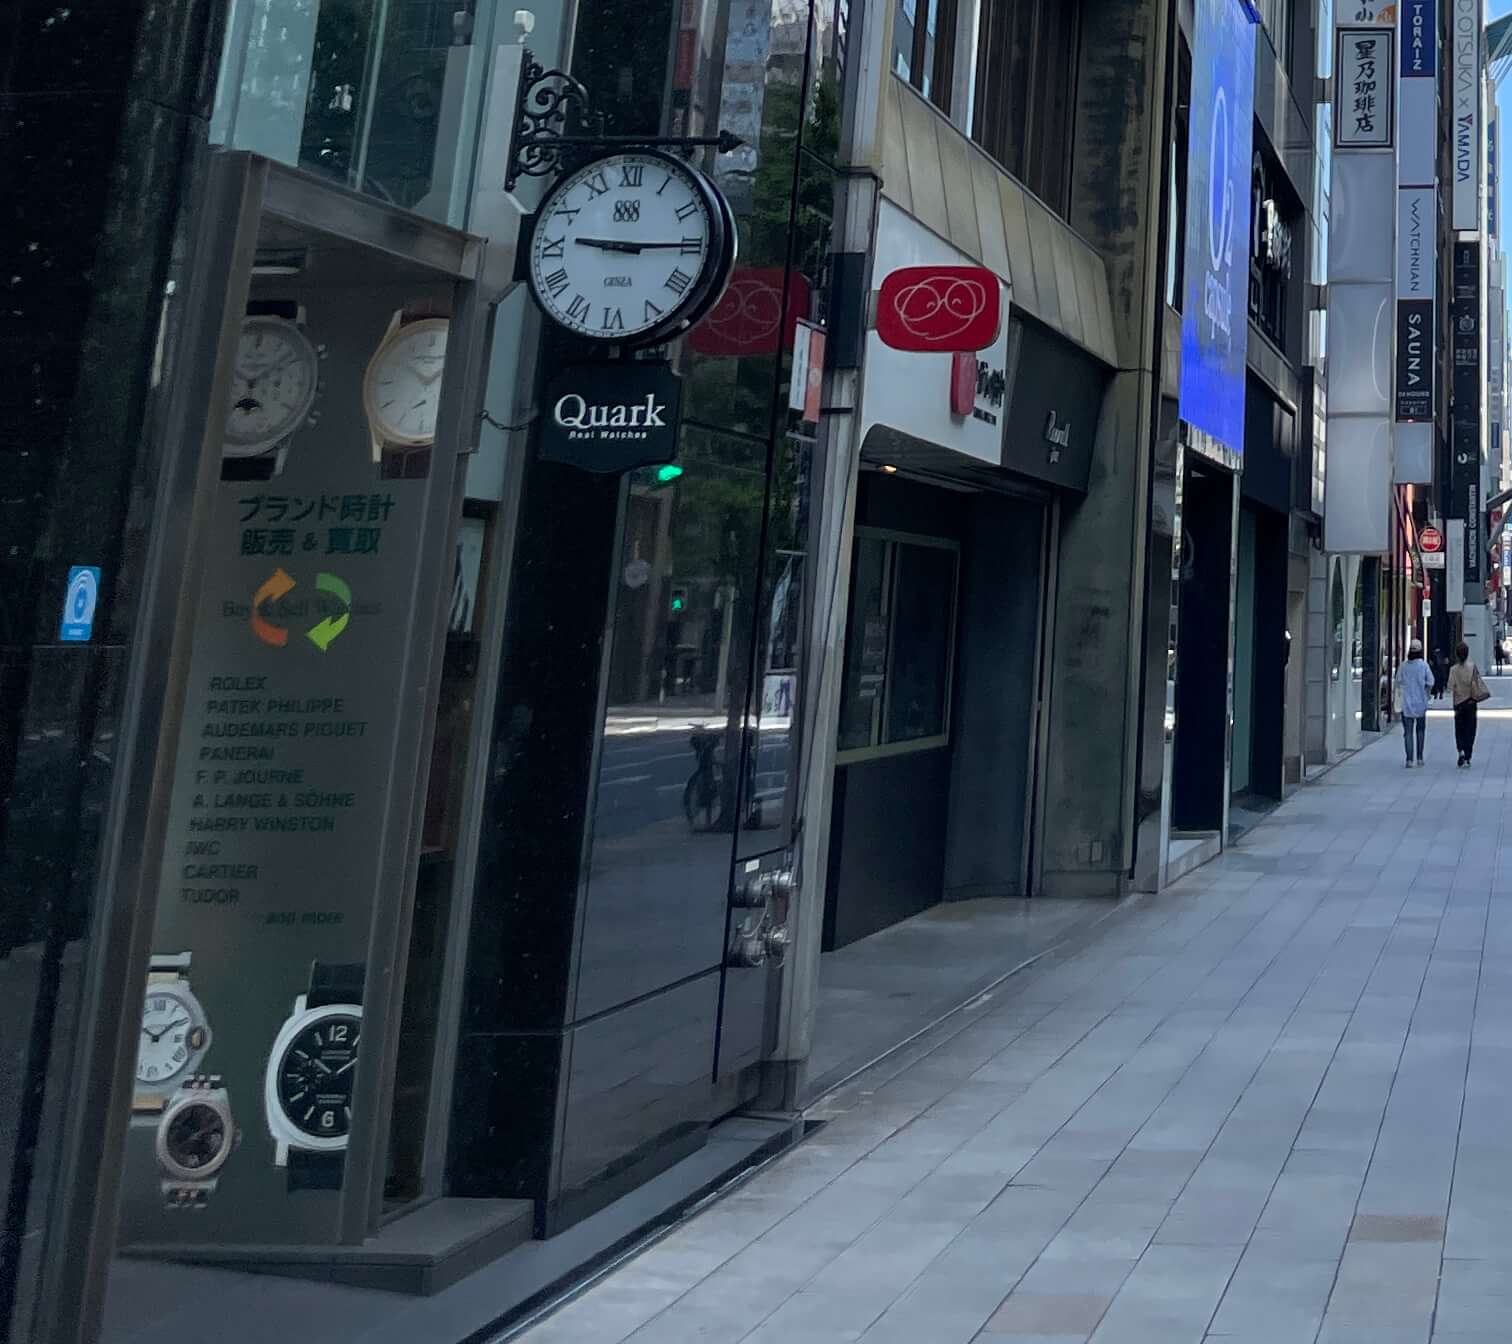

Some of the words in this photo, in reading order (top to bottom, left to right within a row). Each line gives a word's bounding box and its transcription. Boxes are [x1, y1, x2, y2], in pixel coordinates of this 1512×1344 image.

[1412, 4, 1423, 71] TORAIZ
[1457, 18, 1473, 93] OTSUKA
[1354, 40, 1376, 134] 星乃珈琲店
[1457, 113, 1473, 183] YAMADA
[619, 166, 643, 187] XII
[1410, 198, 1421, 292] WATCHNIAN
[1407, 313, 1422, 385] SAUNA
[554, 393, 666, 429] Quark
[209, 677, 267, 691] ROLEX
[207, 699, 266, 713] PATEK
[267, 699, 345, 713] PHILIPPE
[203, 722, 298, 737] AUDEMARS
[200, 746, 274, 761] PANERAI
[182, 865, 258, 880] CARTIER
[181, 888, 240, 904] TUDOR
